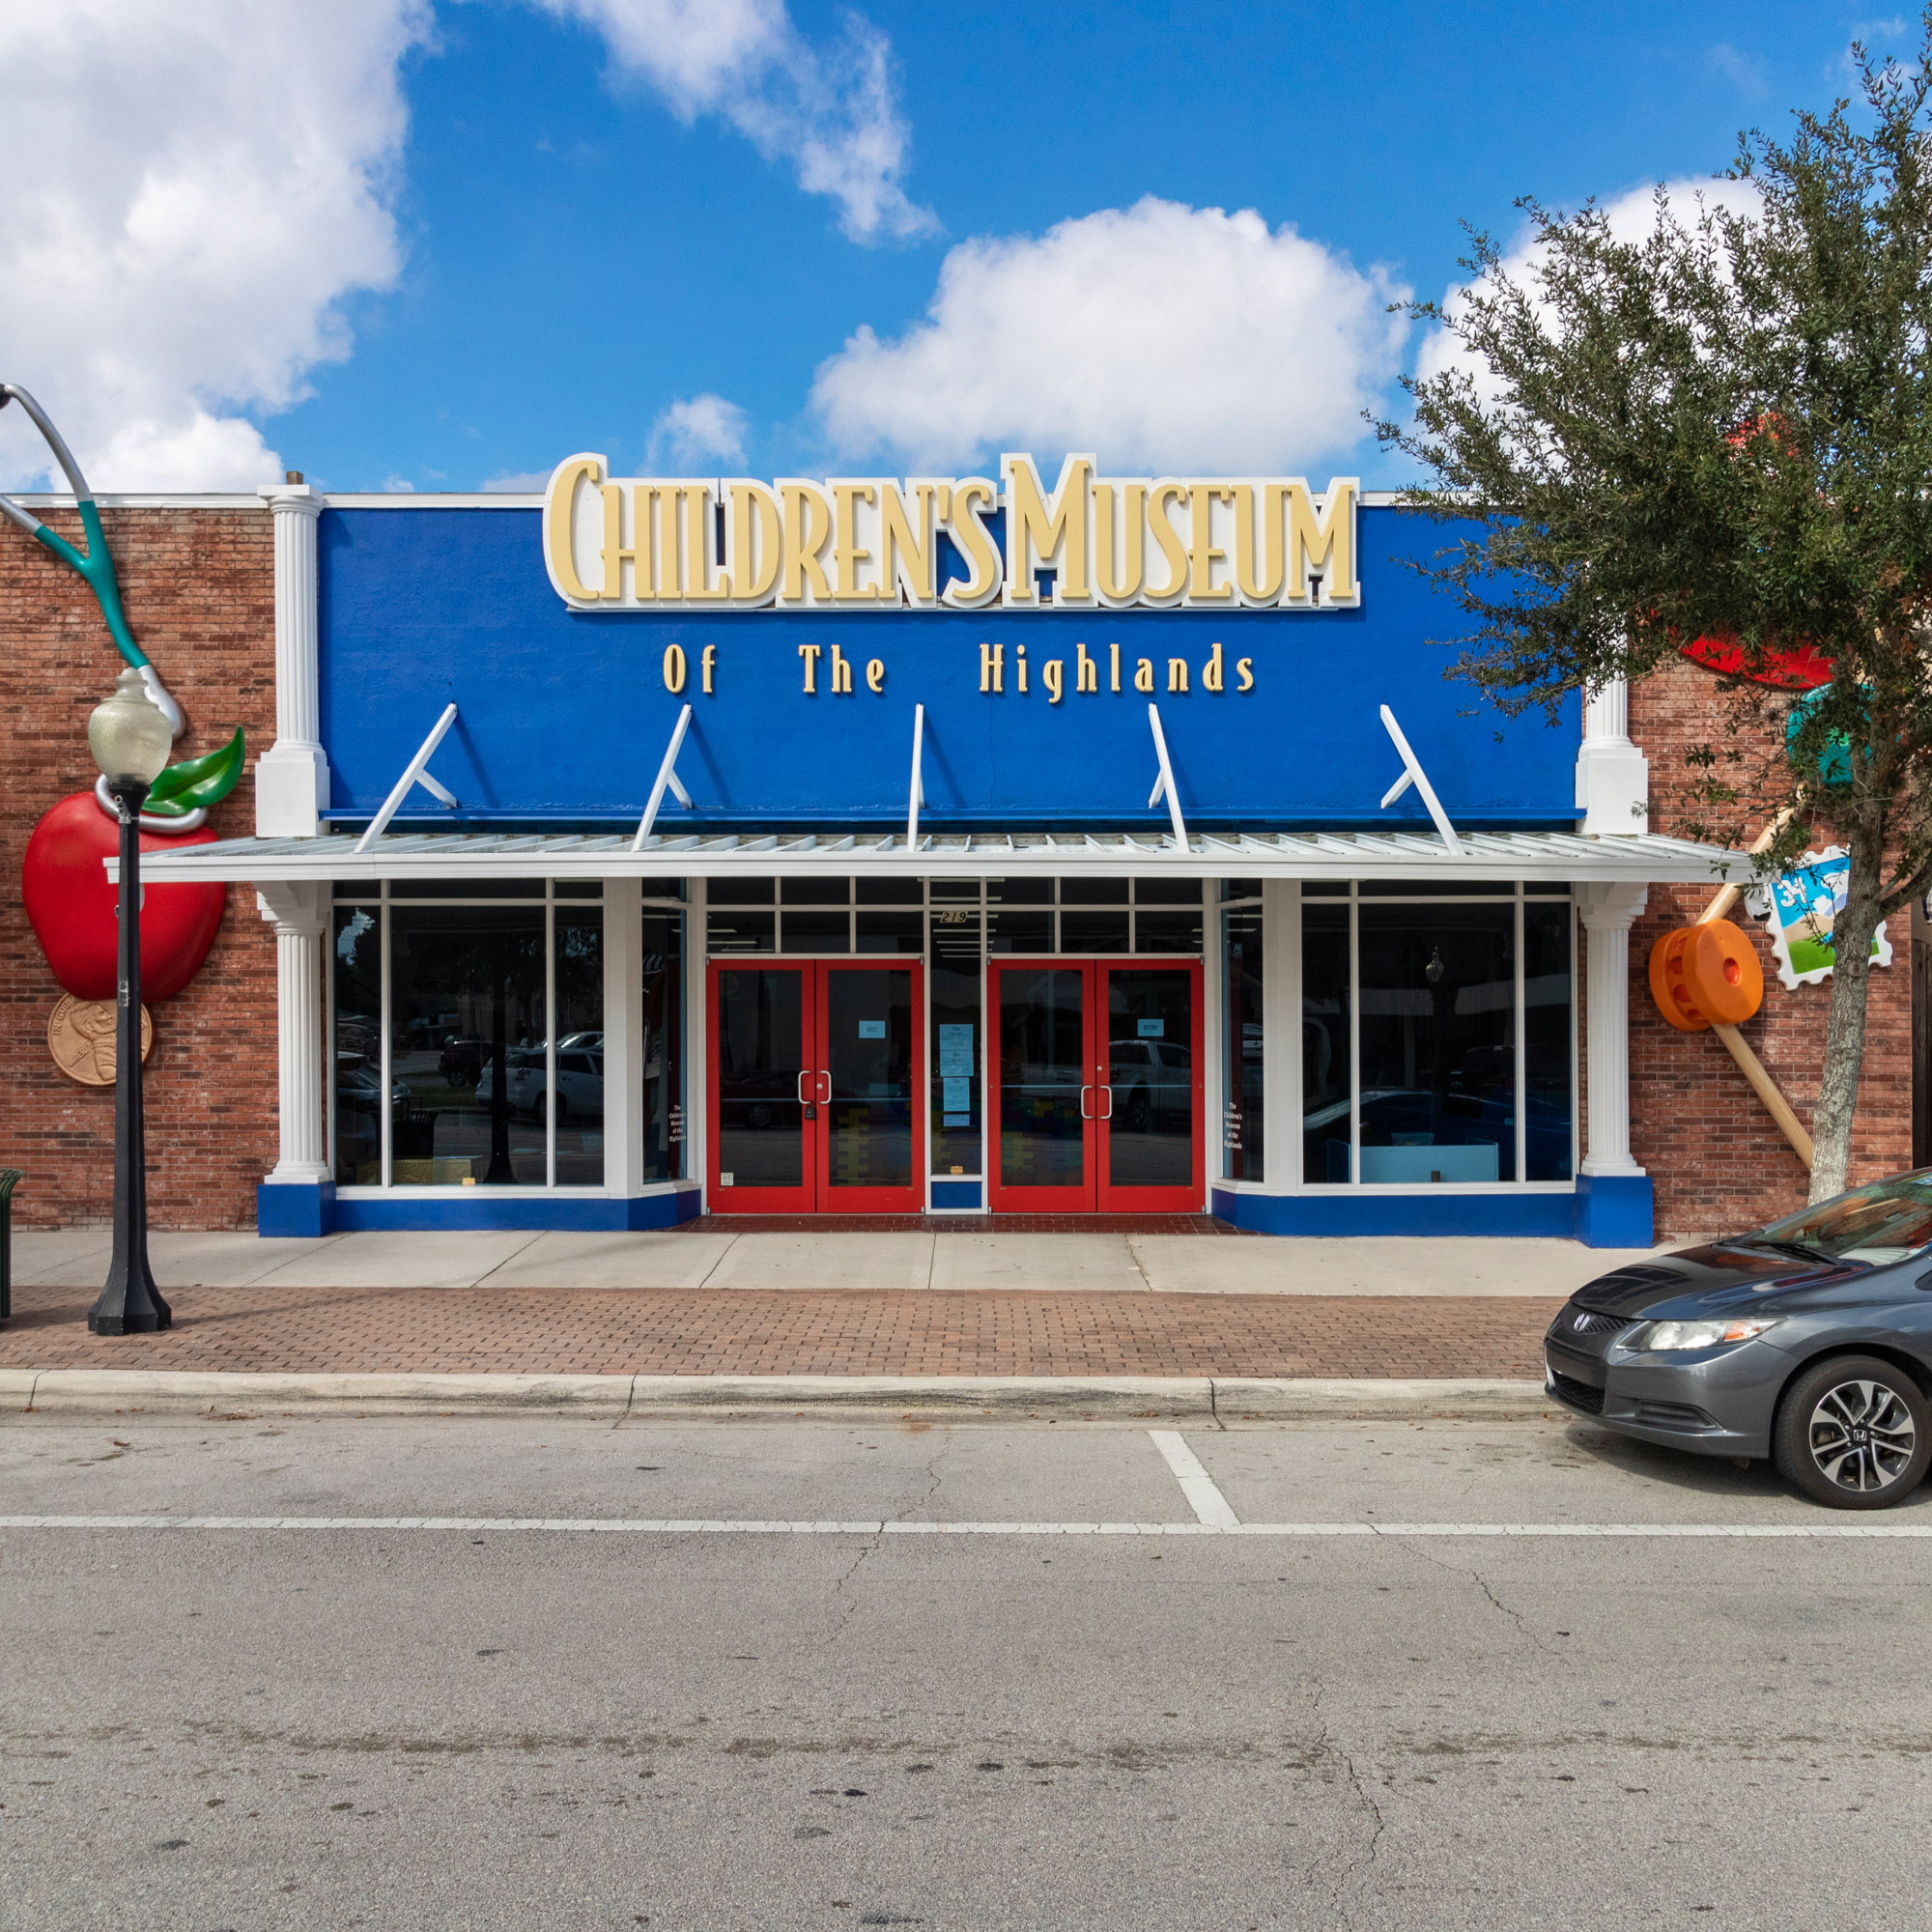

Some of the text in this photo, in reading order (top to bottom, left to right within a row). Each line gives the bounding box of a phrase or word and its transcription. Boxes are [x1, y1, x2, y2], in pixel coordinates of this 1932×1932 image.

[549, 459, 1353, 601] CHILDREN'S MUSEUM
[663, 642, 1254, 703] Of The Highlands
[1776, 876, 1807, 908] 34
[941, 912, 967, 923] 219
